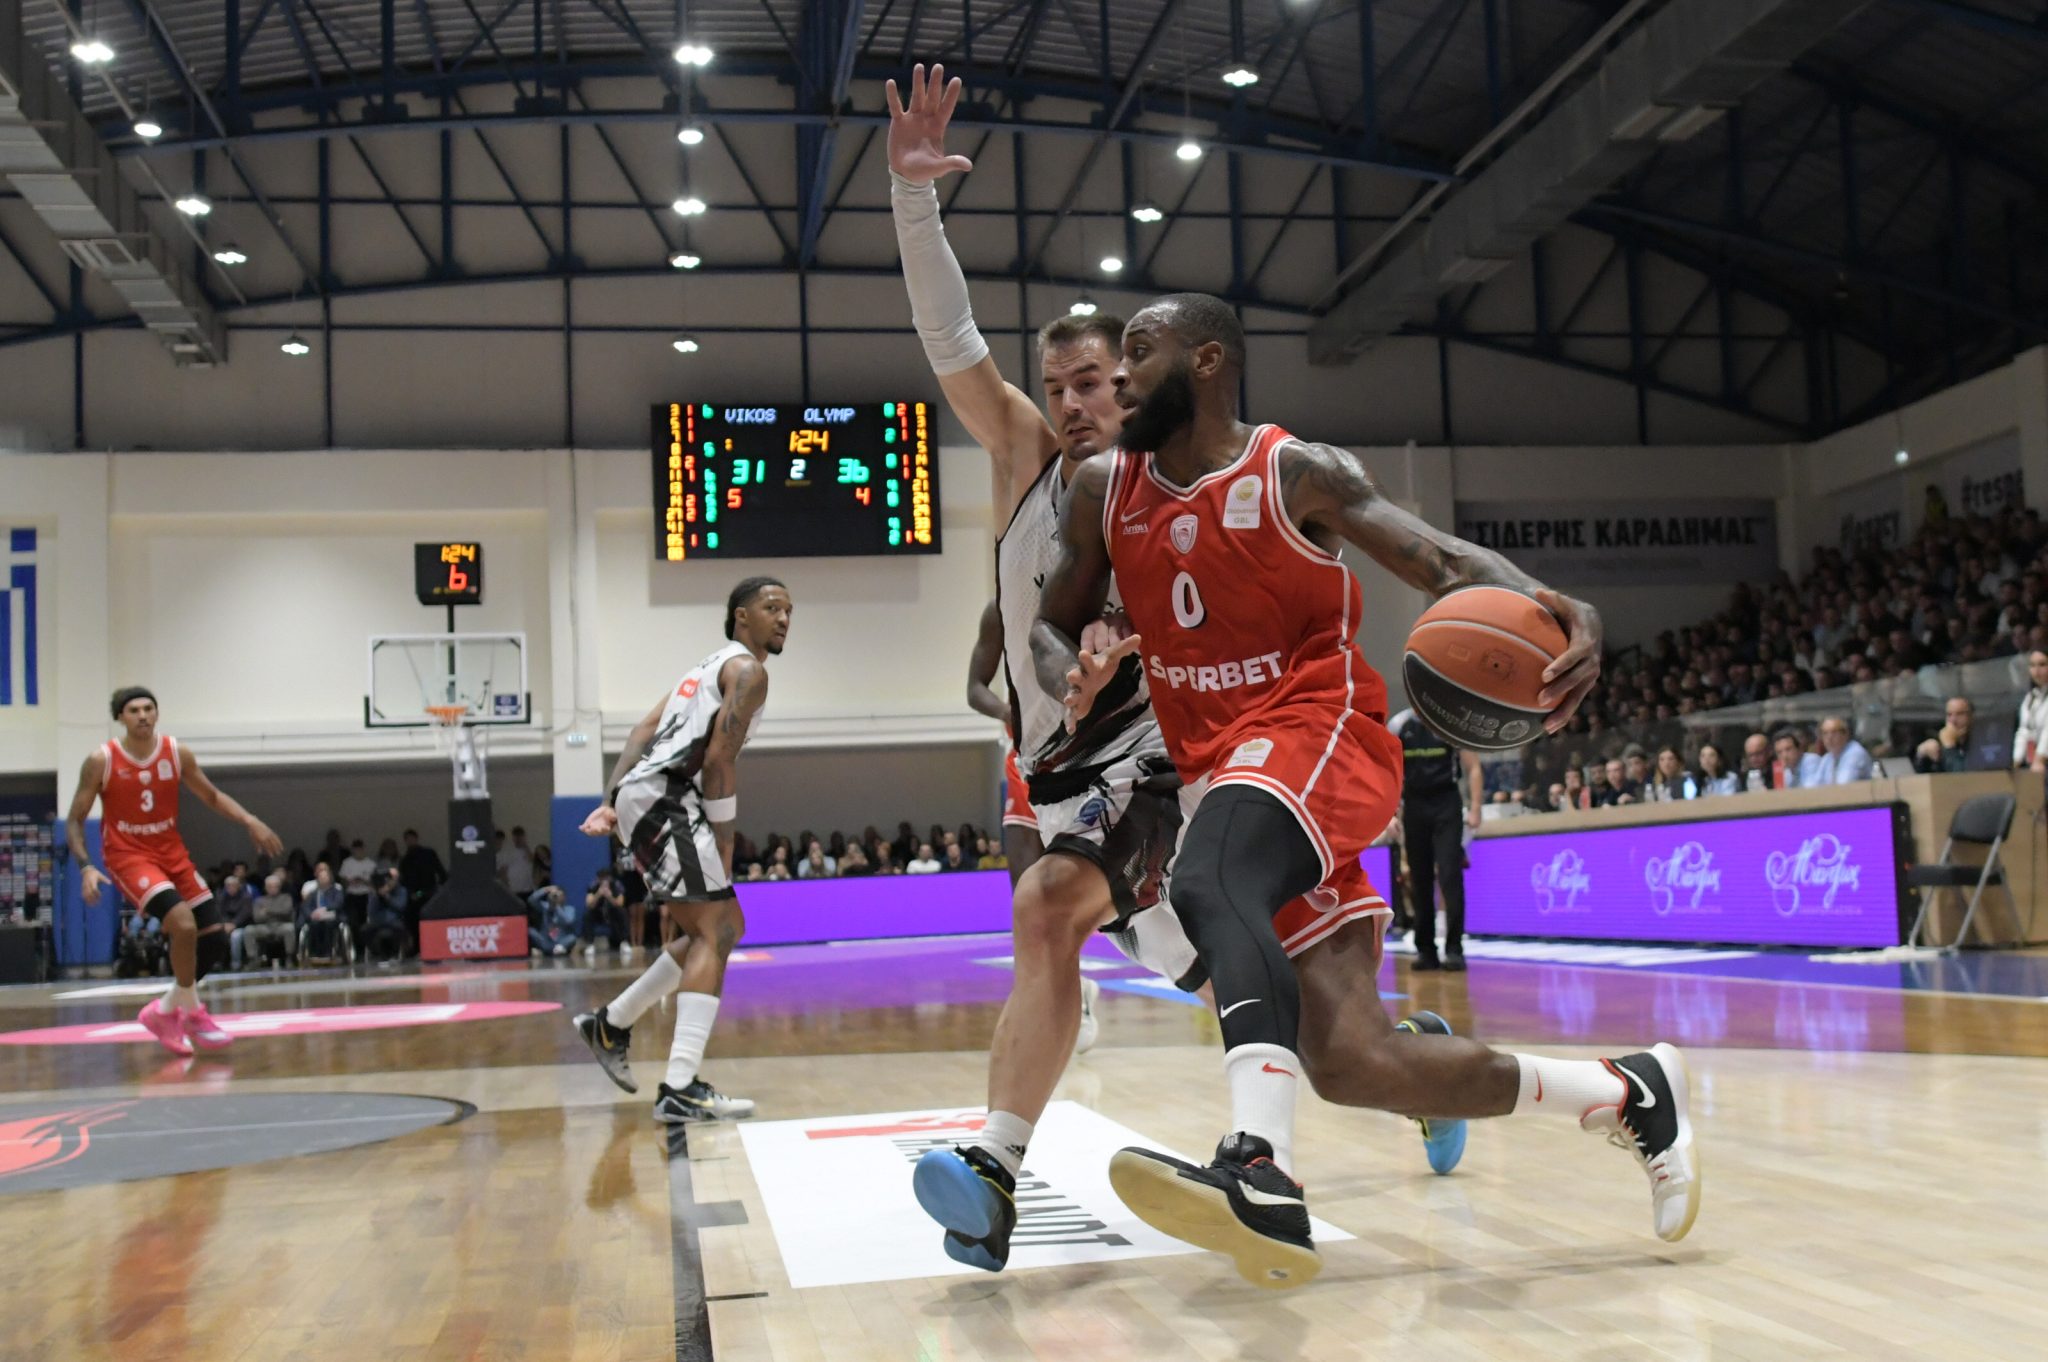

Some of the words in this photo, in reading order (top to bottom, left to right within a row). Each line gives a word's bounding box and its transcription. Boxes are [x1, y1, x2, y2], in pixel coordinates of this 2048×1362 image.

[725, 408, 777, 424] VIKOS
[804, 408, 856, 424] OLYMP
[789, 430, 829, 454] 1:24
[731, 459, 765, 485] 31
[790, 458, 806, 480] 2
[727, 488, 742, 509] 5
[855, 487, 870, 506] 4
[441, 544, 475, 563] 1:24
[449, 564, 468, 591] 6
[1172, 571, 1204, 628] 0
[1150, 651, 1282, 692] SPERBET
[141, 789, 153, 813] 3
[449, 939, 498, 954] COLA
